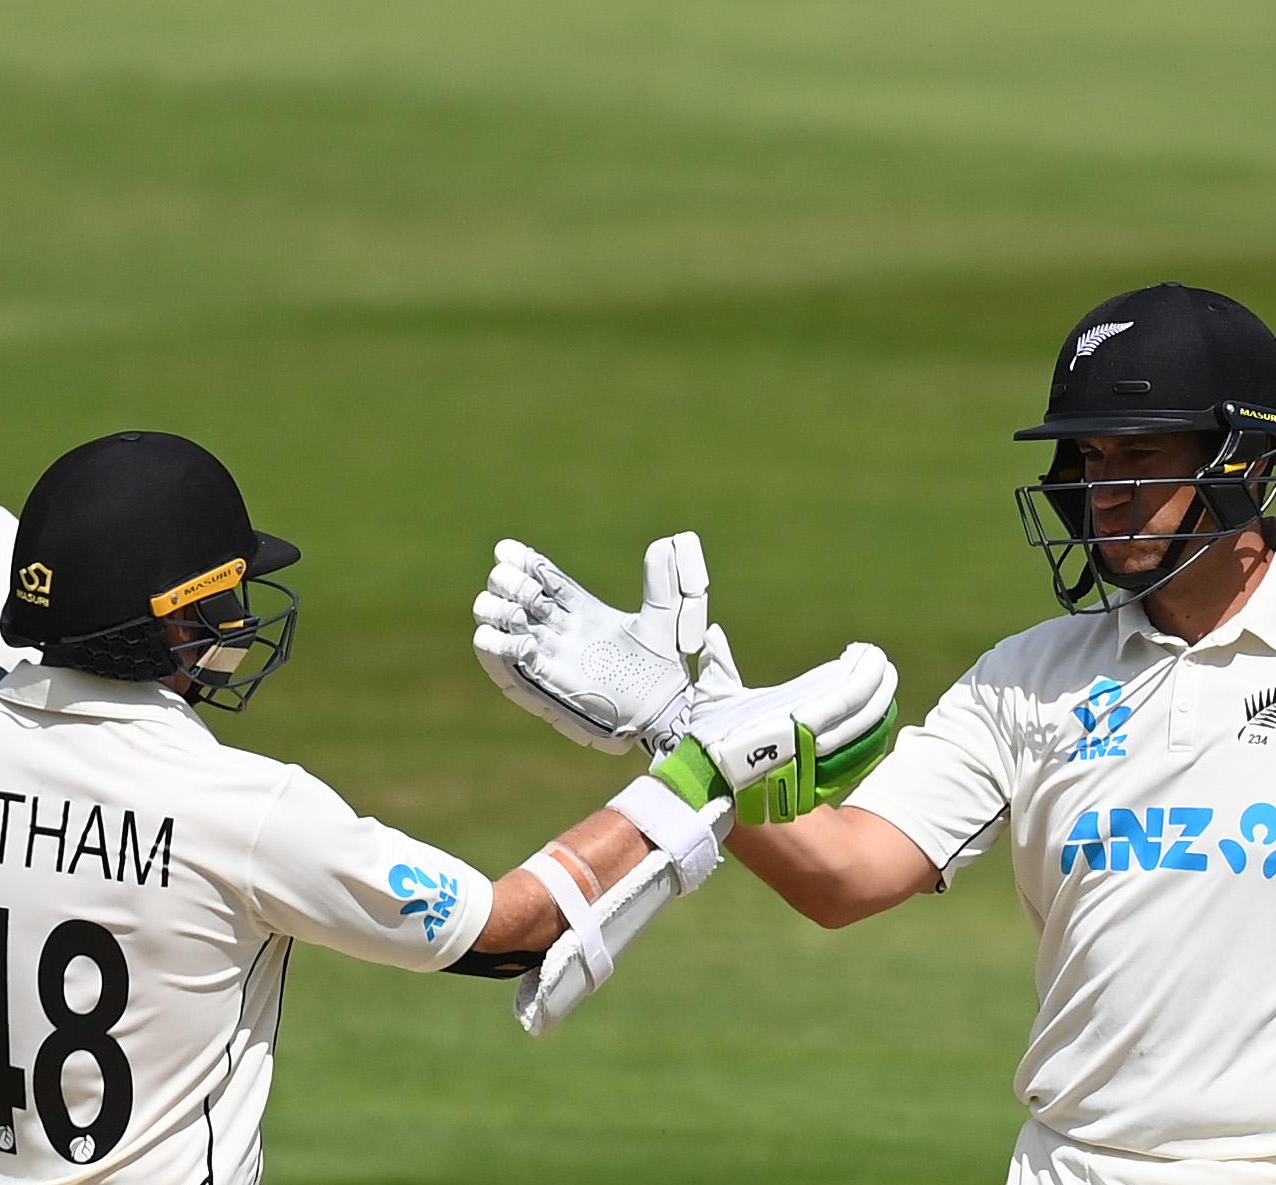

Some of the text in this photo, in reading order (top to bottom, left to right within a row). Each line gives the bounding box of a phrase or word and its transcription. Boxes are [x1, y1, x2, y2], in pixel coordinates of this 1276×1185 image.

[183, 568, 232, 596] MASURI
[1067, 734, 1129, 763] ANZ
[1247, 733, 1269, 746] 234
[1061, 807, 1214, 875] ANZ
[423, 872, 458, 943] ANZ
